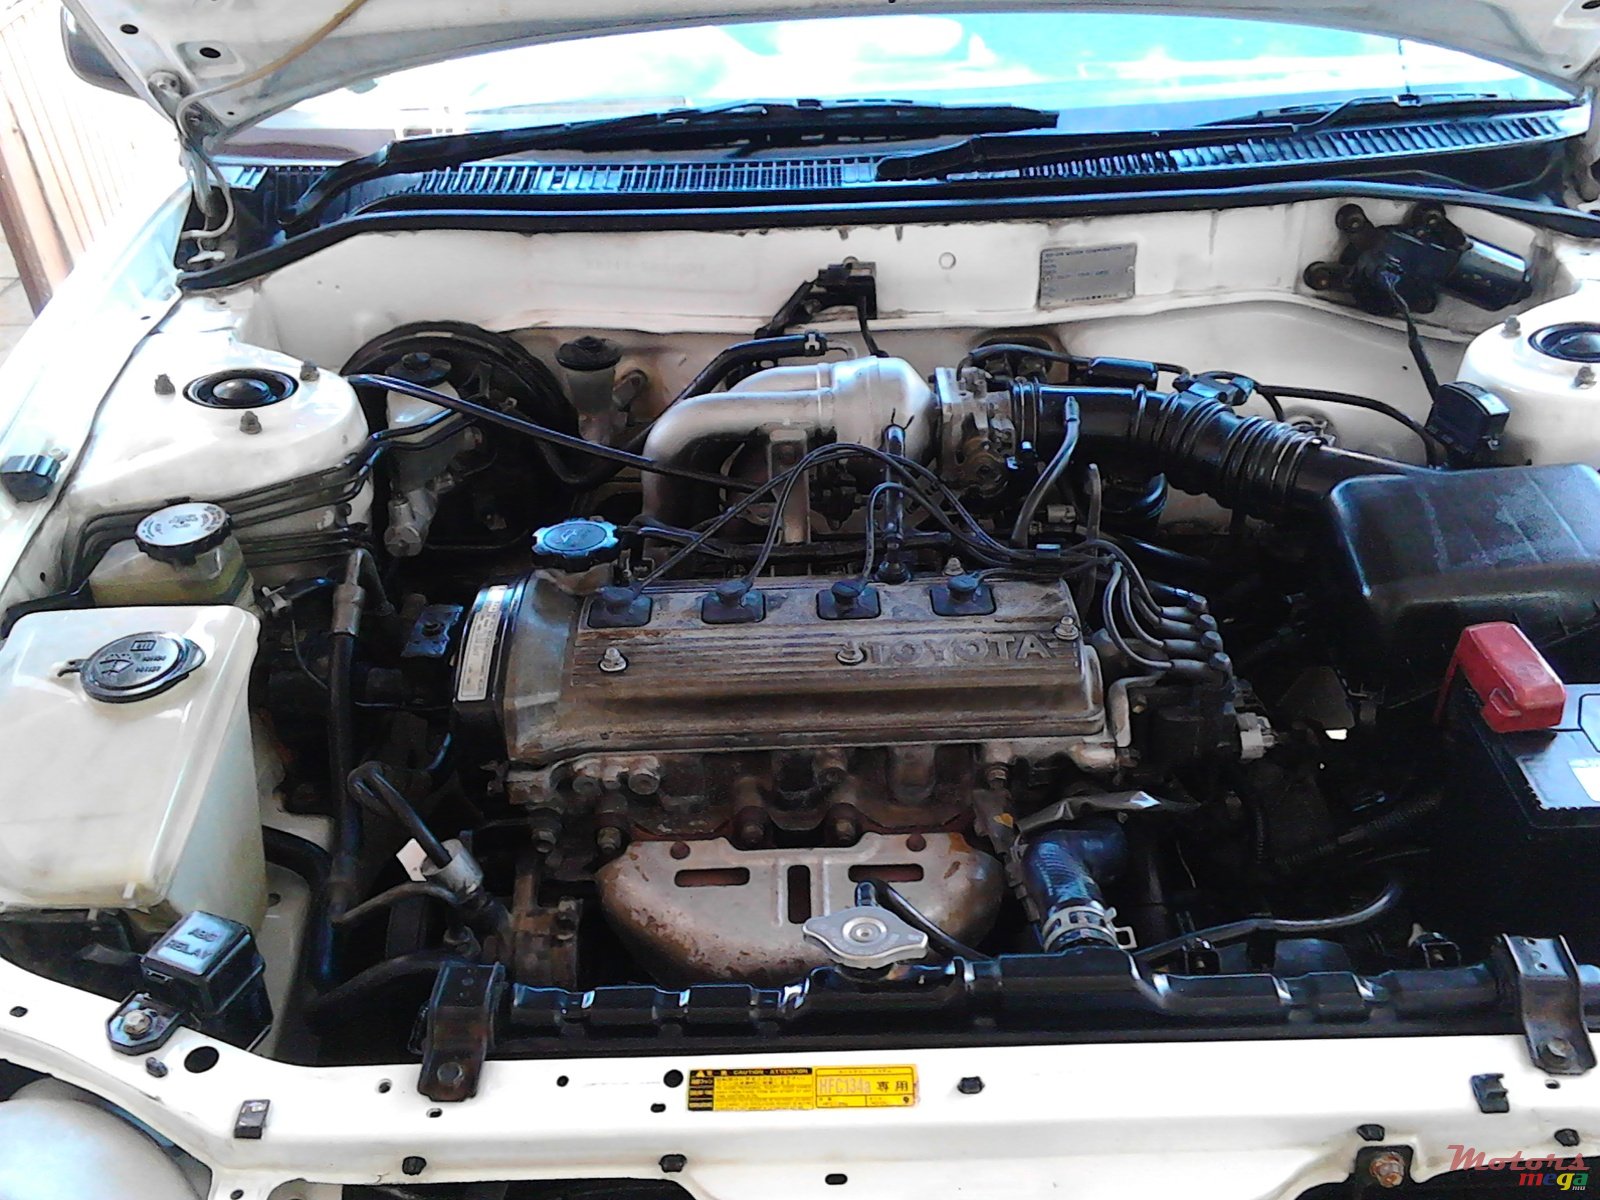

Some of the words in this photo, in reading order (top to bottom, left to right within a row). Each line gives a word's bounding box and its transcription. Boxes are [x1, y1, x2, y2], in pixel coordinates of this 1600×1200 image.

[861, 632, 1052, 664] TOYOTA
[165, 940, 212, 960] RELAY
[819, 1077, 871, 1094] HFC134a
